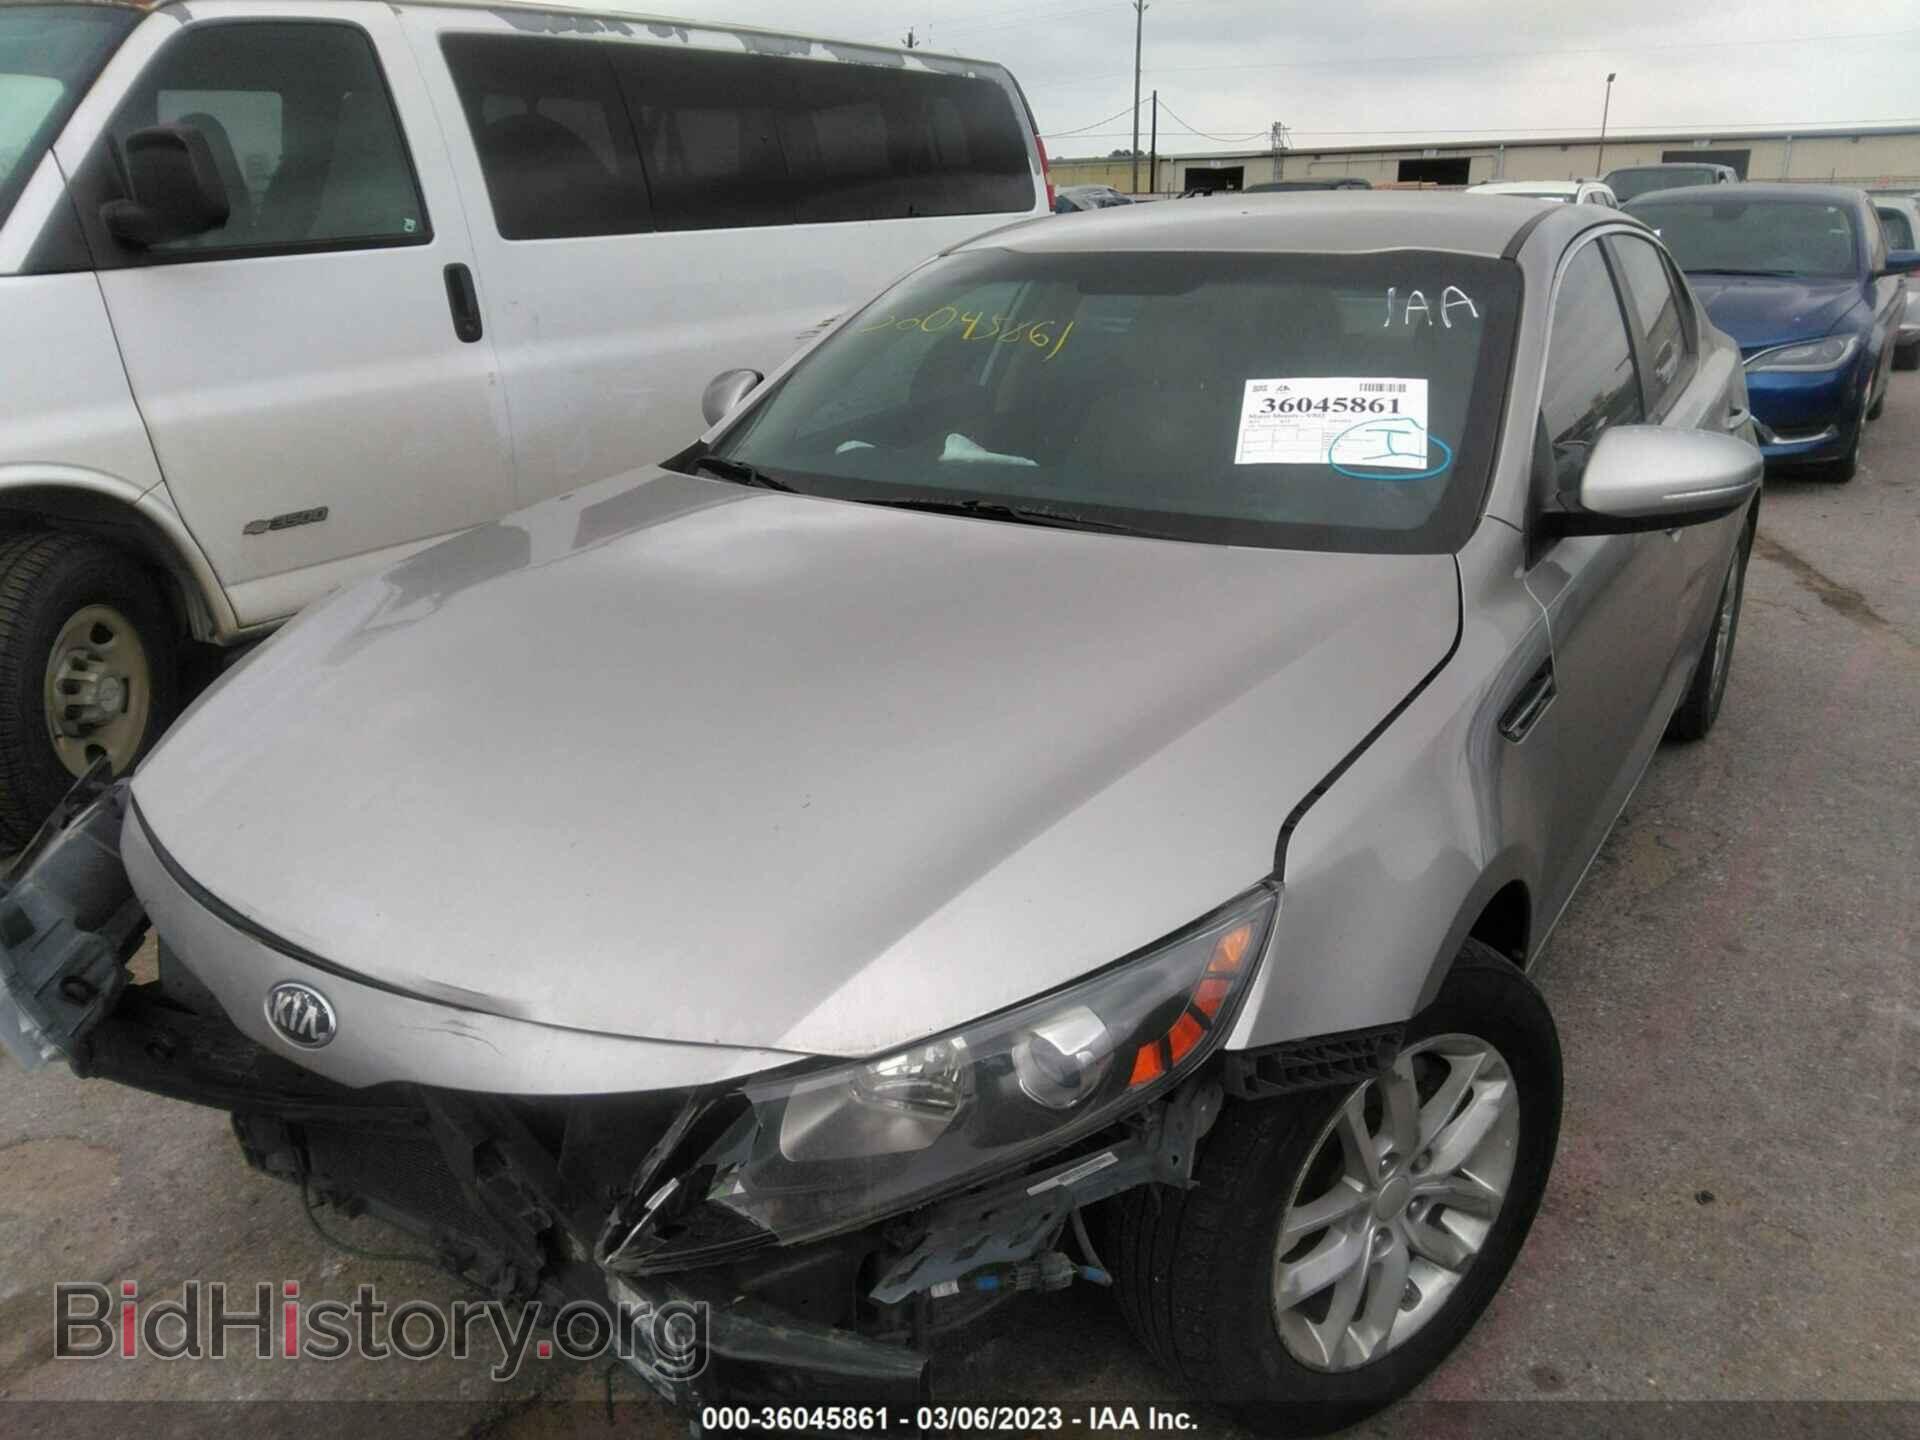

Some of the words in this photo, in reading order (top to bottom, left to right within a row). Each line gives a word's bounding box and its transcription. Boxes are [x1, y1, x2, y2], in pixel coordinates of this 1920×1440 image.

[1383, 286, 1479, 328] IAA
[1259, 396, 1401, 415] 36045861
[271, 989, 320, 1041] KIA
